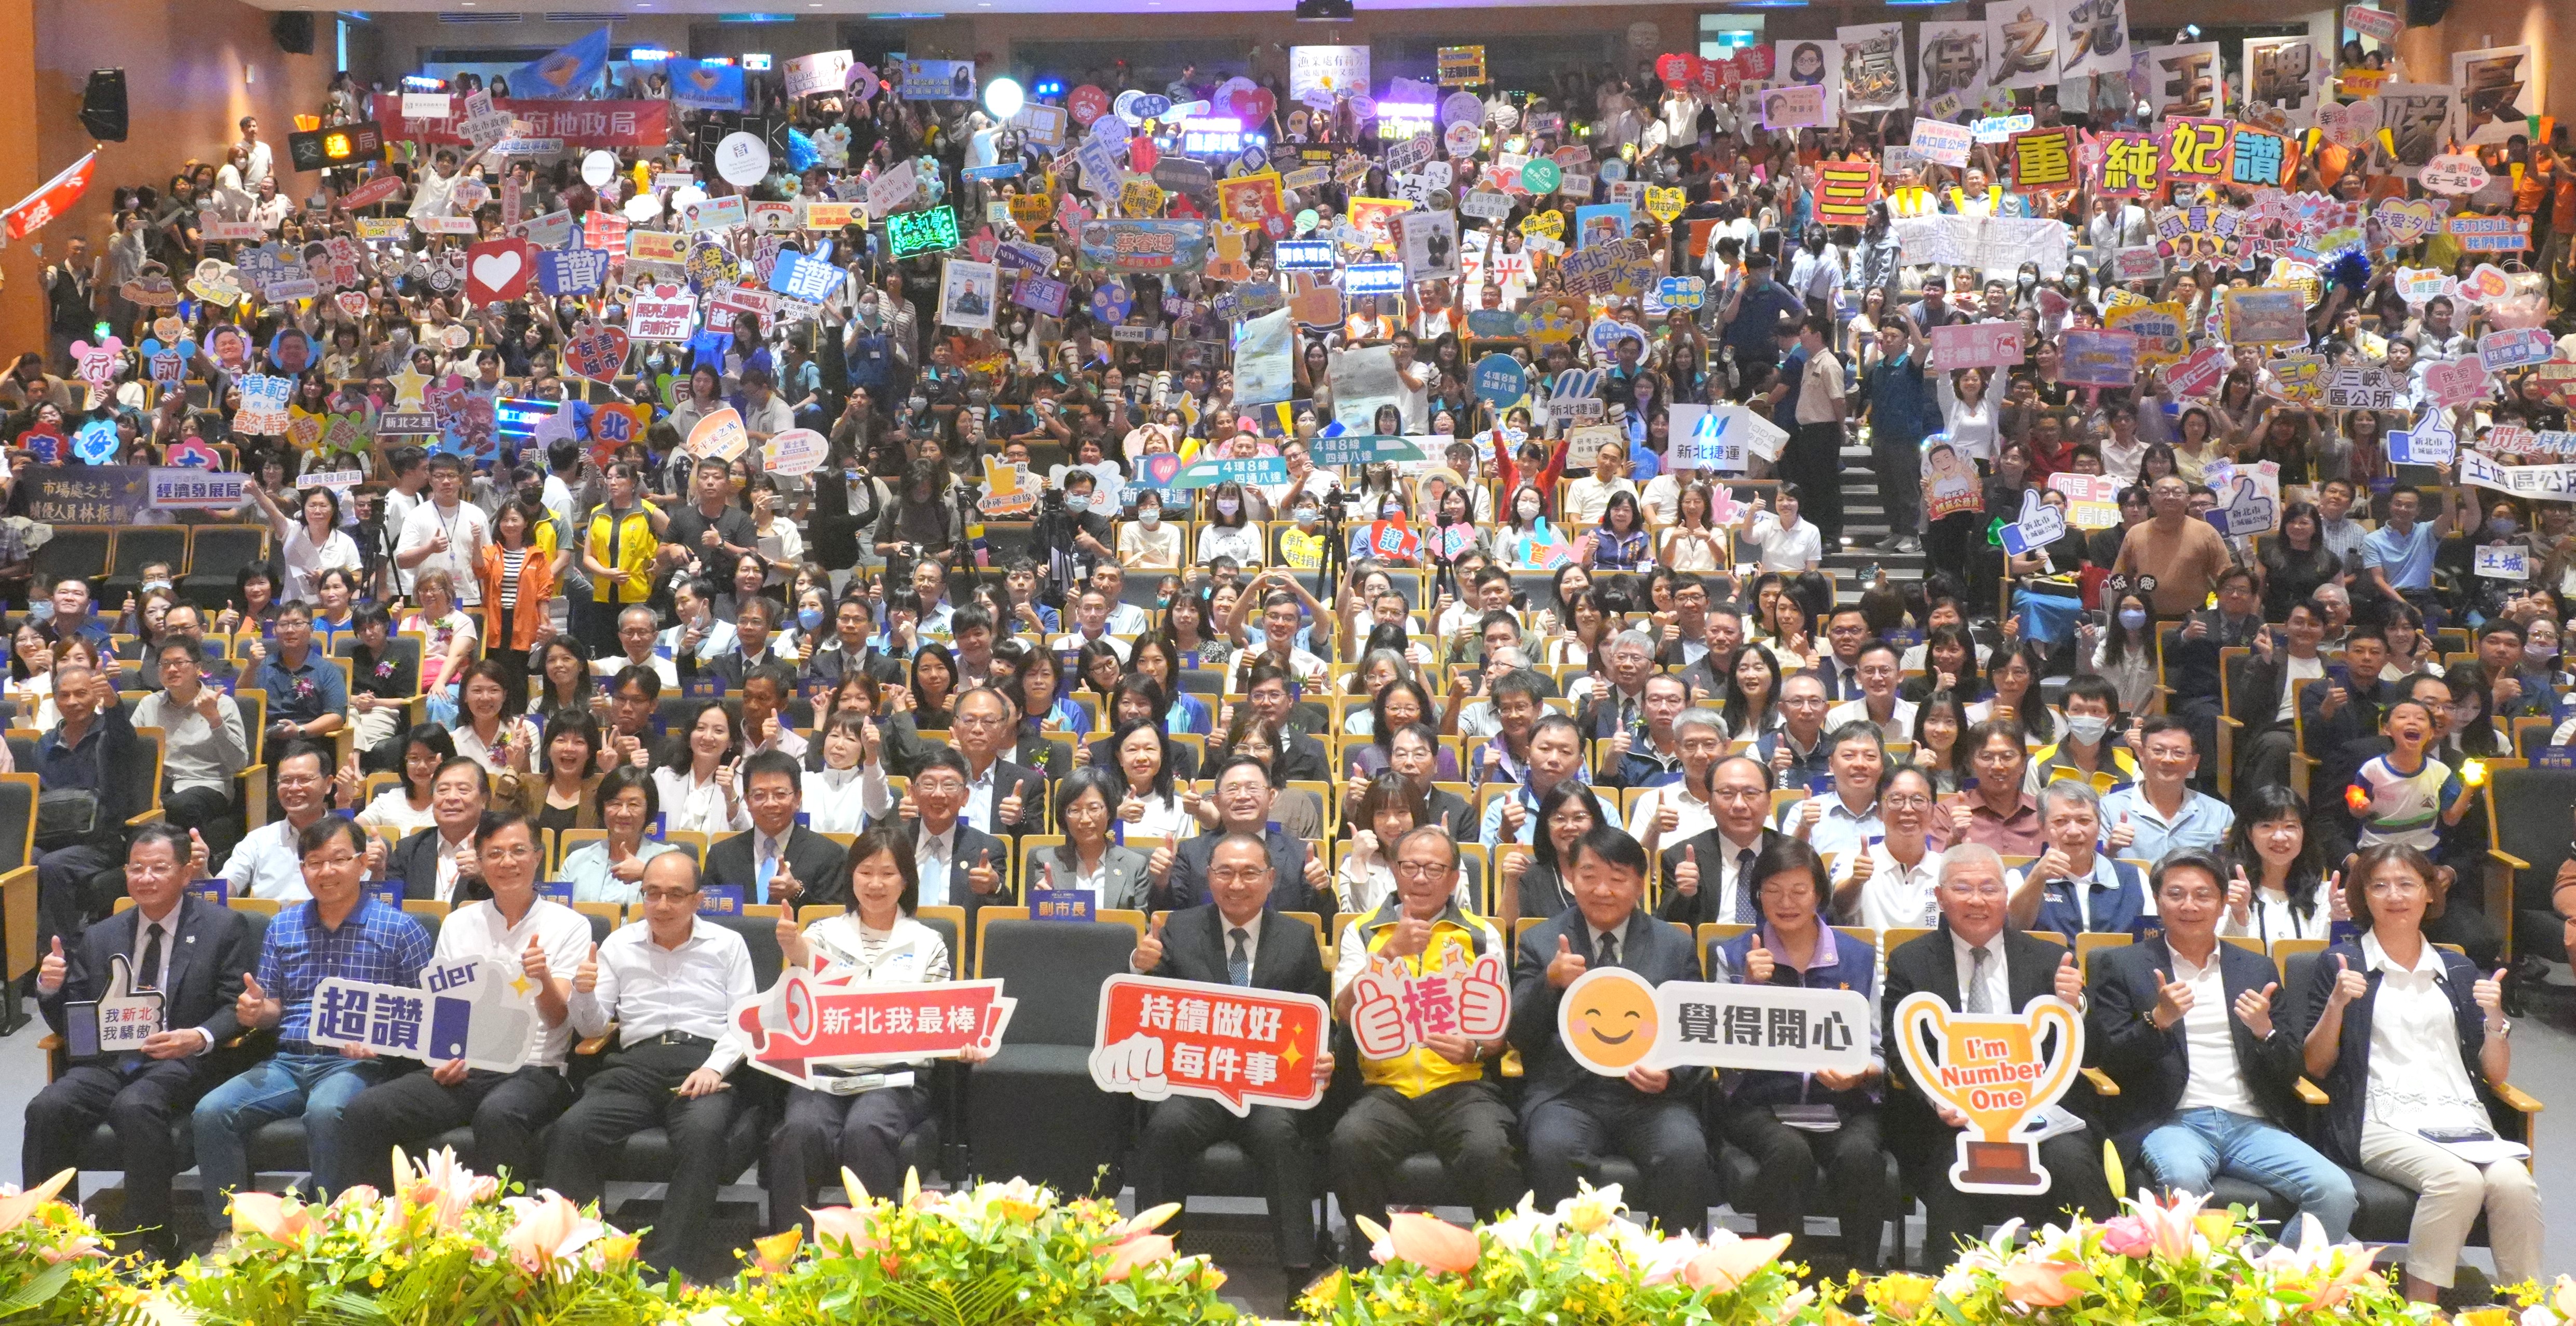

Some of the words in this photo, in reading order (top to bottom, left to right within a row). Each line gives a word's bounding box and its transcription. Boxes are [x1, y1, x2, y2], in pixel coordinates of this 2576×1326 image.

[2063, 0, 2124, 72] 光
[1989, 7, 2056, 86] 之
[1667, 60, 1687, 80] 愛
[2253, 43, 2311, 110] 牌
[2158, 52, 2213, 121] 王
[2461, 55, 2527, 140] 長
[461, 117, 509, 137] 新北市政府
[475, 129, 502, 142] 青年局
[296, 130, 377, 160] 交通局
[1390, 143, 1409, 157] 防災
[1916, 134, 1967, 151] 林口區公所
[2168, 121, 2227, 175] 妃
[1389, 150, 1423, 169] 南波萬
[2016, 131, 2070, 184] 重
[2103, 137, 2159, 190] 純
[2233, 131, 2283, 186] 讚
[2433, 161, 2483, 175] 永遠和您
[2426, 174, 2468, 187] 在一起
[1125, 184, 1158, 199] 新北
[1650, 189, 1679, 200] 新北
[1819, 169, 1871, 215] 三
[1467, 205, 1505, 218] 我去見山
[1650, 201, 1681, 212] 財政局
[1525, 213, 1557, 227] 新北
[2375, 211, 2438, 234] 我愛汐止
[2450, 218, 2509, 233] 活力汐止
[2466, 235, 2525, 249] 我們最棒
[239, 252, 274, 269] 主角
[997, 248, 1017, 262] NEW
[1018, 258, 1043, 275] WATER
[1565, 240, 1649, 277] 新北河濱
[555, 251, 598, 292] 讚
[787, 258, 831, 298] 讚
[1460, 261, 1481, 285] 之
[1497, 260, 1525, 286] 光
[1567, 265, 1653, 297] 幸福水漾
[1028, 279, 1053, 299] 炎昌
[2413, 280, 2440, 294] 萬里
[636, 303, 690, 320] 照亮溫暖
[639, 321, 680, 335] 向前行
[84, 355, 110, 378] 行
[154, 354, 180, 380] 前
[2442, 367, 2470, 382] 我愛
[1483, 372, 1516, 384] 4環8線
[2340, 369, 2381, 386] 三峽
[240, 375, 291, 401] 模範
[1483, 381, 1516, 394] 四通八達
[2282, 381, 2322, 400] 之光
[241, 402, 284, 411] 公務人員
[2330, 389, 2392, 408] 區公所
[1550, 403, 1600, 415] 新北捷運
[235, 410, 289, 434] 懿靜
[386, 416, 432, 428] 新北之星
[601, 412, 630, 440] 北
[700, 420, 738, 450] 平溪之光
[2415, 437, 2443, 446] 新北市
[2492, 428, 2576, 452] 閃亮坪林
[1314, 439, 1360, 452] 4環8線
[1677, 444, 1739, 460] 新北捷運
[1223, 461, 1269, 472] 4環8線
[1326, 451, 1372, 463] 四通八達
[298, 472, 361, 485] 經濟發展局
[1016, 464, 1026, 485] 超讚
[1135, 458, 1146, 482] I
[1234, 473, 1282, 483] 四通八達
[42, 482, 112, 498] 市場處之光
[157, 482, 241, 498] 經濟發展局
[2057, 478, 2089, 497] 你是
[982, 493, 1032, 509] 捷運三鶯線
[1935, 498, 1979, 512] 模範公務員
[2025, 516, 2049, 530] 新北市
[2233, 508, 2260, 520] 新北市
[1380, 527, 1404, 553] 讚
[2484, 555, 2523, 571] 土城
[2113, 577, 2126, 589] 城
[704, 898, 734, 912] 利局
[1039, 901, 1086, 918] 副市長
[1925, 888, 1936, 927] 楊宗珉
[428, 960, 479, 993] der
[105, 1007, 153, 1024] 我新北
[317, 986, 422, 1050] 超讚
[1140, 993, 1283, 1043] 持續做好
[1403, 979, 1458, 1038] 棒
[103, 1025, 151, 1041] 我驕傲
[1678, 1002, 1853, 1053] 覺得開心
[1966, 1038, 2006, 1060] I'm
[1171, 1041, 1279, 1087] 每件事
[1941, 1062, 2044, 1088] Number
[1972, 1089, 2025, 1110] One
